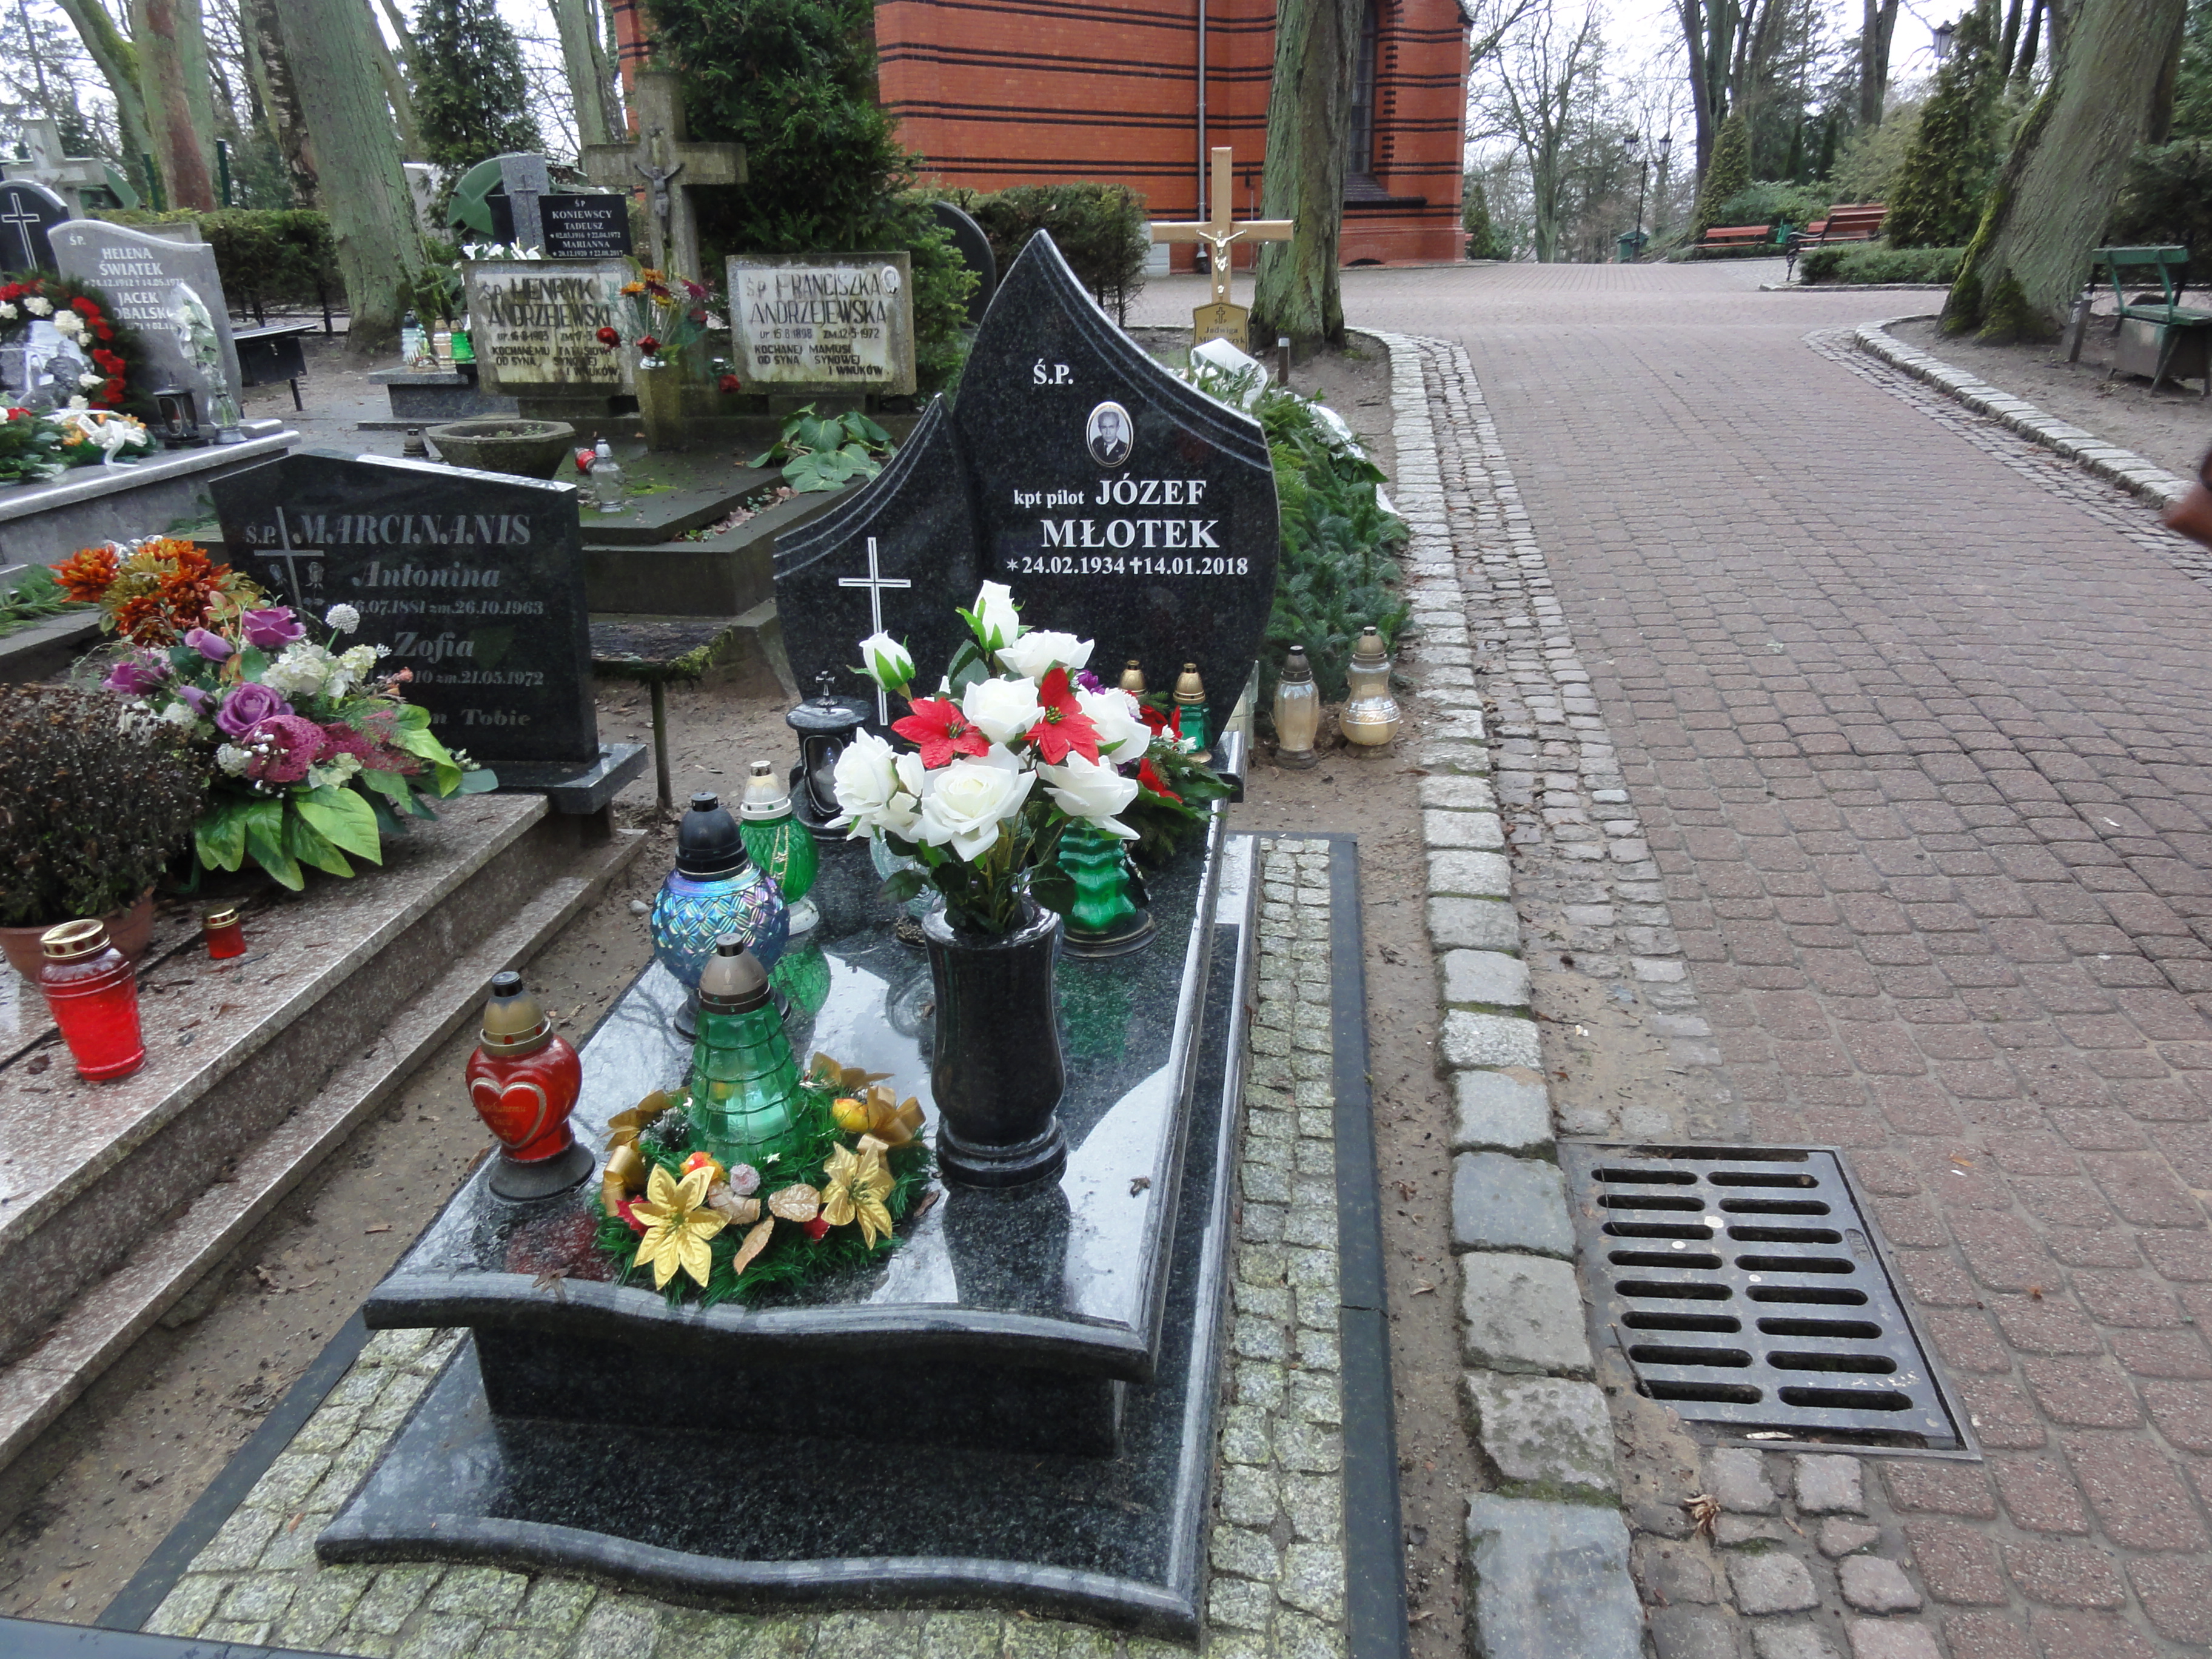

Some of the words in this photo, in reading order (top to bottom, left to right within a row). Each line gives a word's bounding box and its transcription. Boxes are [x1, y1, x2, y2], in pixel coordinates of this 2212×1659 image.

[552, 210, 612, 220] KONIEWSCY
[101, 247, 153, 260] HELENA
[511, 278, 594, 300] HENRYK
[775, 273, 880, 298] FRANCISZKA
[117, 292, 159, 306] JACEK
[489, 303, 612, 328] ANDRZEJEWSKI
[750, 301, 887, 327] ANDRZEJEWSKA
[1204, 327, 1239, 335] Jadwiga
[492, 346, 550, 356] KOCHANEMU
[754, 344, 803, 355] KOCHANEJ
[758, 355, 771, 364] OD
[814, 355, 860, 364] SYNOWEJ
[496, 357, 509, 366] OD
[1033, 358, 1074, 385] Ś.P.
[1013, 490, 1042, 508] kpt
[1046, 490, 1085, 508] pilot
[1095, 473, 1207, 506] JÓZEF
[293, 514, 532, 545] MARCINANIS
[1040, 519, 1221, 549] MŁOTEK
[351, 560, 501, 588] Antonina
[393, 631, 475, 665] Zofia
[460, 709, 532, 726] Tobie
